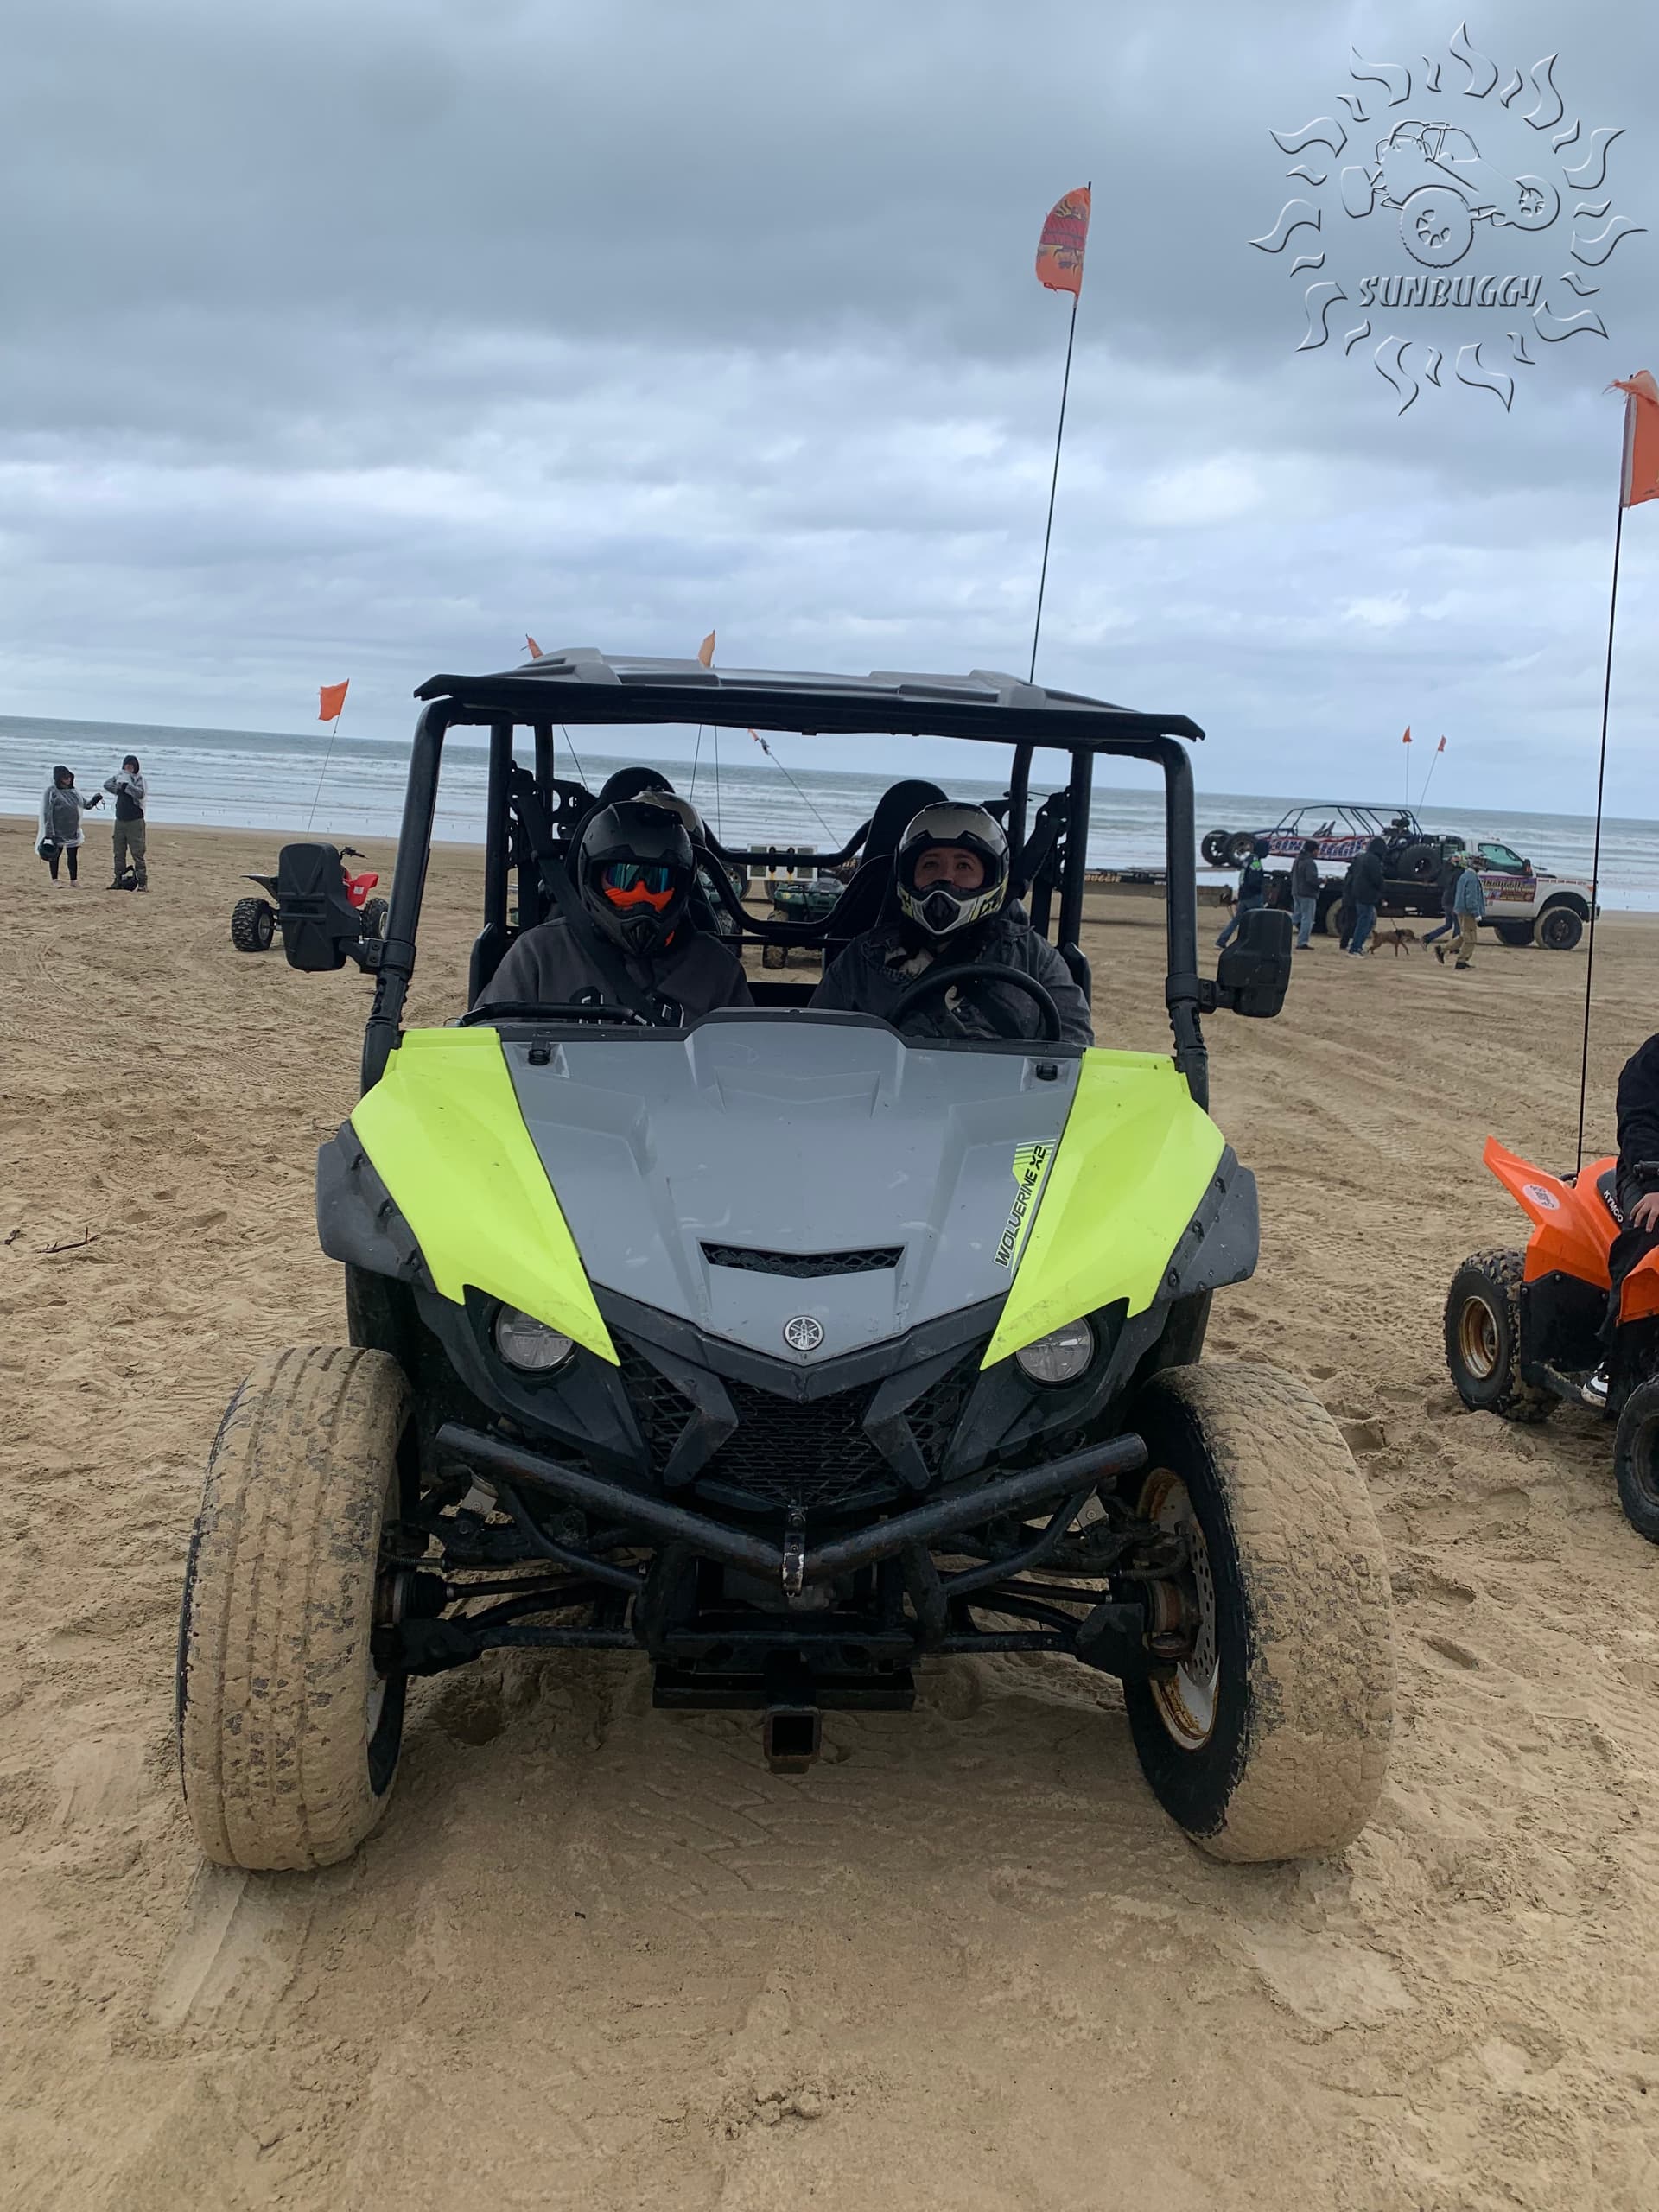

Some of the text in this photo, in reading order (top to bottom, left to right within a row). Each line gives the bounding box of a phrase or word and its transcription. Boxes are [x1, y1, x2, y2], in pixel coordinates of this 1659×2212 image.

[995, 1145, 1047, 1267] WOLVERINE X2
[1603, 1189, 1624, 1223] KYMCO
